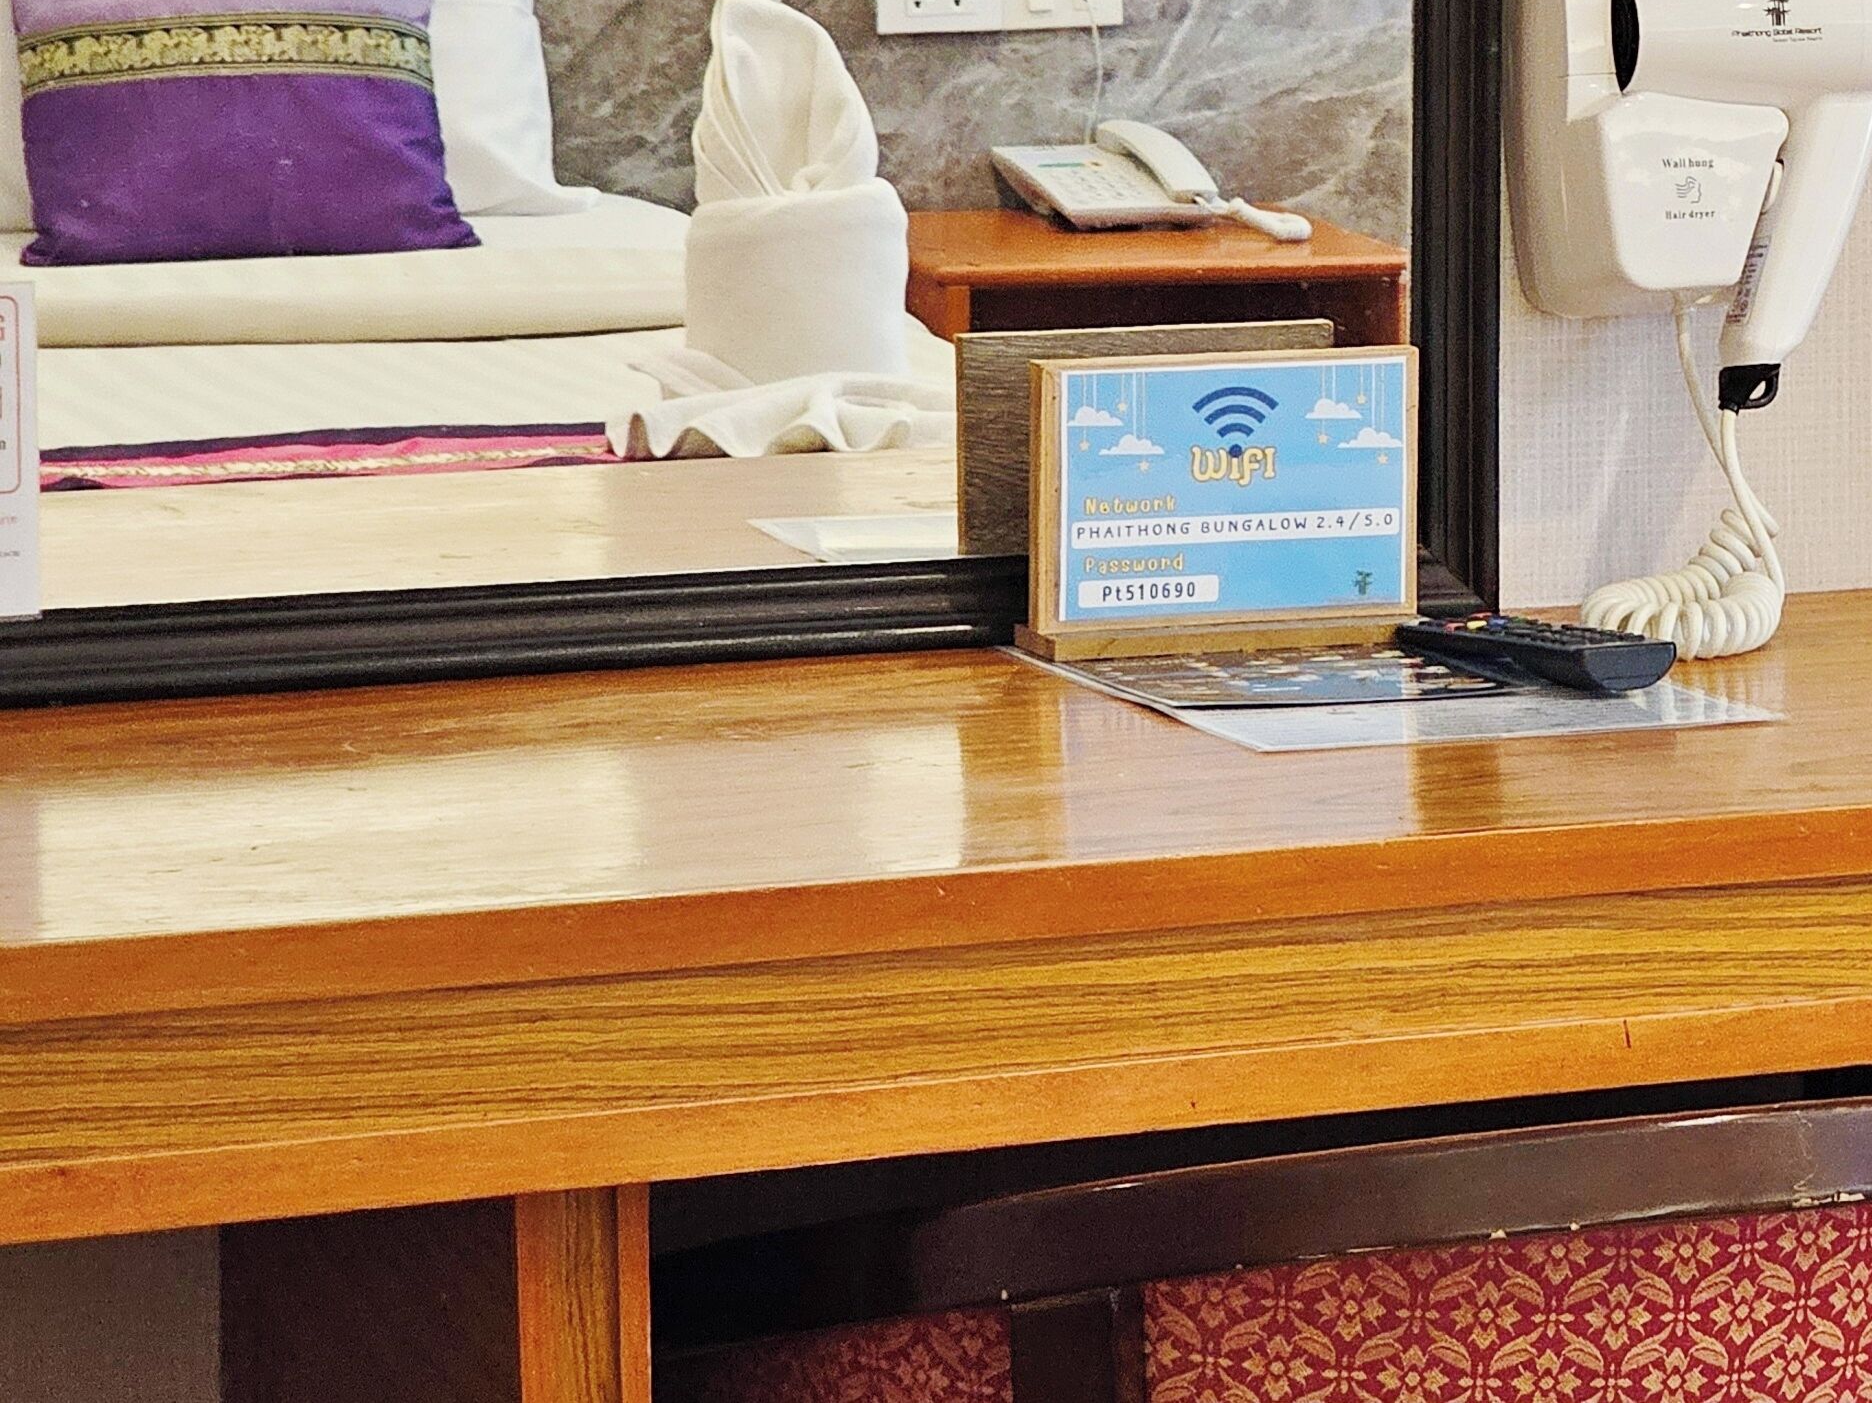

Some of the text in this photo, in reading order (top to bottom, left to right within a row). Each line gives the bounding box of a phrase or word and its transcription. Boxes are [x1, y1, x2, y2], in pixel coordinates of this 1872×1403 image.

[1662, 158, 1686, 168] Wall
[1665, 209, 1716, 220] Hair dryer
[1084, 495, 1176, 515] Network
[1076, 511, 1394, 540] PHAITHONG BUNGALOW 2.4/5.0
[1085, 553, 1185, 575] Password
[1102, 581, 1197, 602] Pt510690
